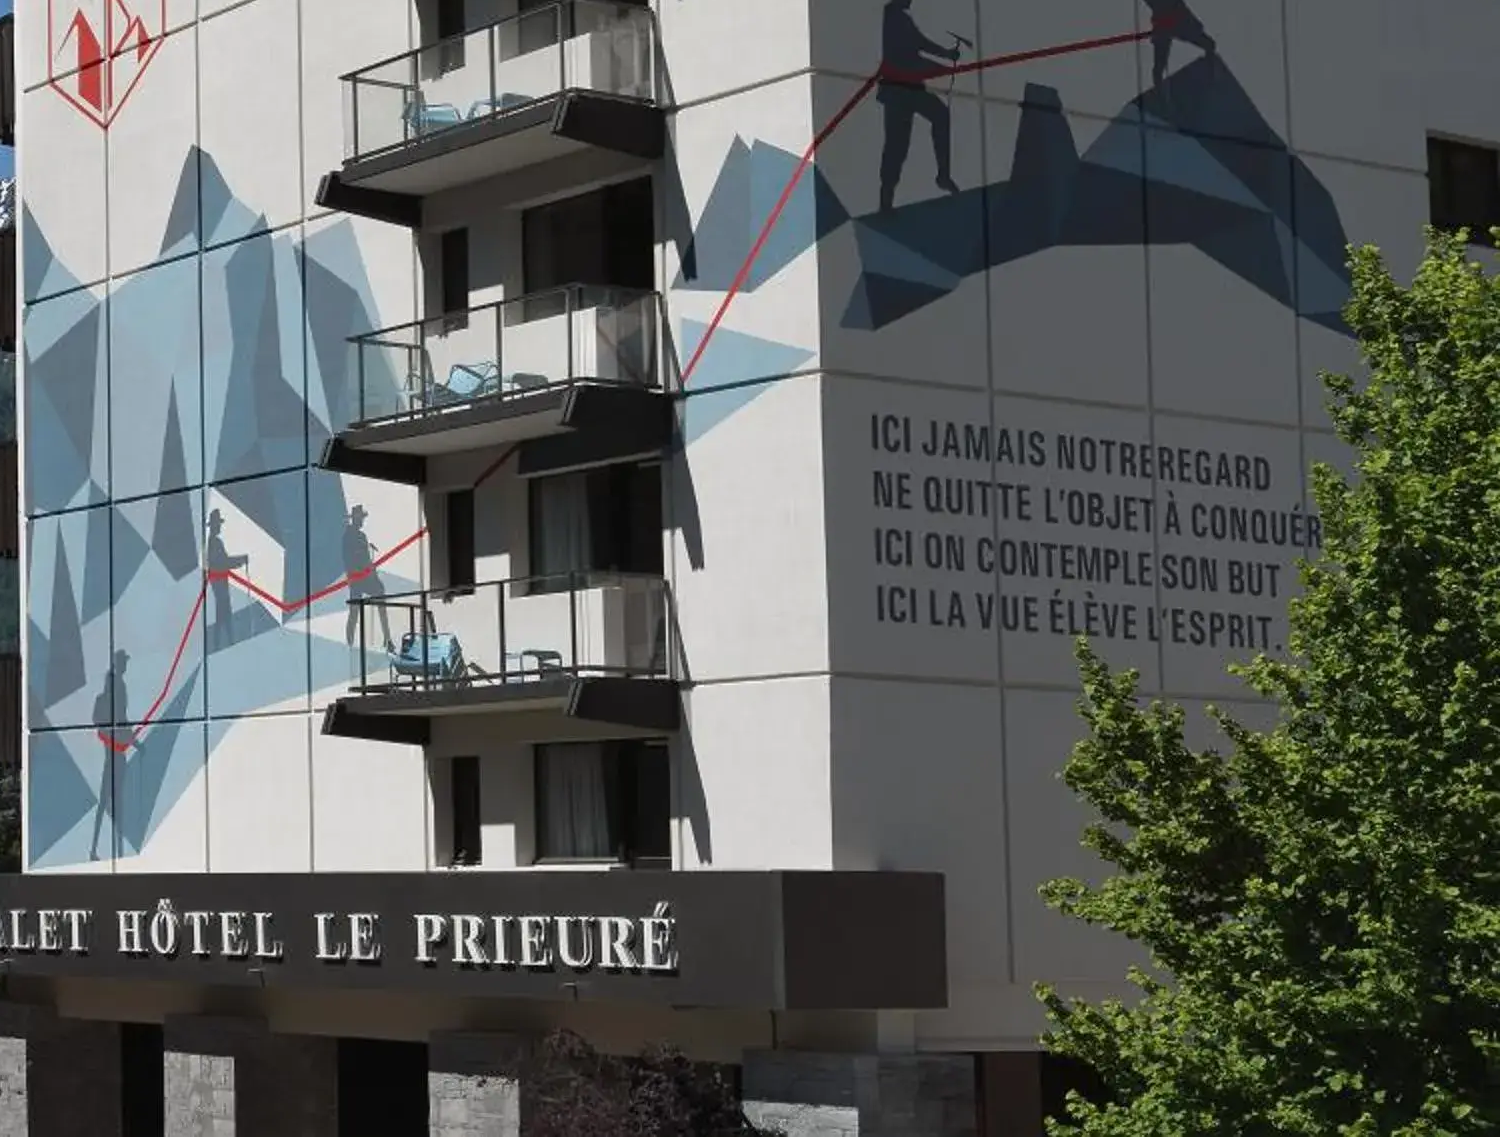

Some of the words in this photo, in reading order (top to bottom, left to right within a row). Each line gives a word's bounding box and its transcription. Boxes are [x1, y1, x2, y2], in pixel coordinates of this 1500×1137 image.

[871, 414, 911, 453] ICI
[922, 420, 1046, 467] JAMAIS
[1057, 434, 1152, 479] NOTRE
[1157, 446, 1271, 491] REGARD
[873, 470, 912, 509] NE
[924, 476, 1032, 521] QUITTE
[1044, 488, 1155, 533] L'OBJET
[1163, 490, 1181, 535] À
[1191, 503, 1321, 549] CONQUÉR
[875, 527, 912, 566] ICI
[925, 532, 964, 571] ON
[977, 537, 1153, 586] CONTEMPLE
[1161, 554, 1218, 592] SON
[1228, 560, 1281, 598] BUT
[877, 585, 917, 624] ICI
[930, 589, 966, 628] LA
[975, 592, 1039, 632] VUE
[1049, 588, 1137, 640] ÉLÈVE
[1147, 606, 1283, 651] L'ESPRIT.
[116, 898, 284, 957] HÔTEL
[314, 913, 381, 961] LE
[413, 901, 680, 970] PRIEURÉ
